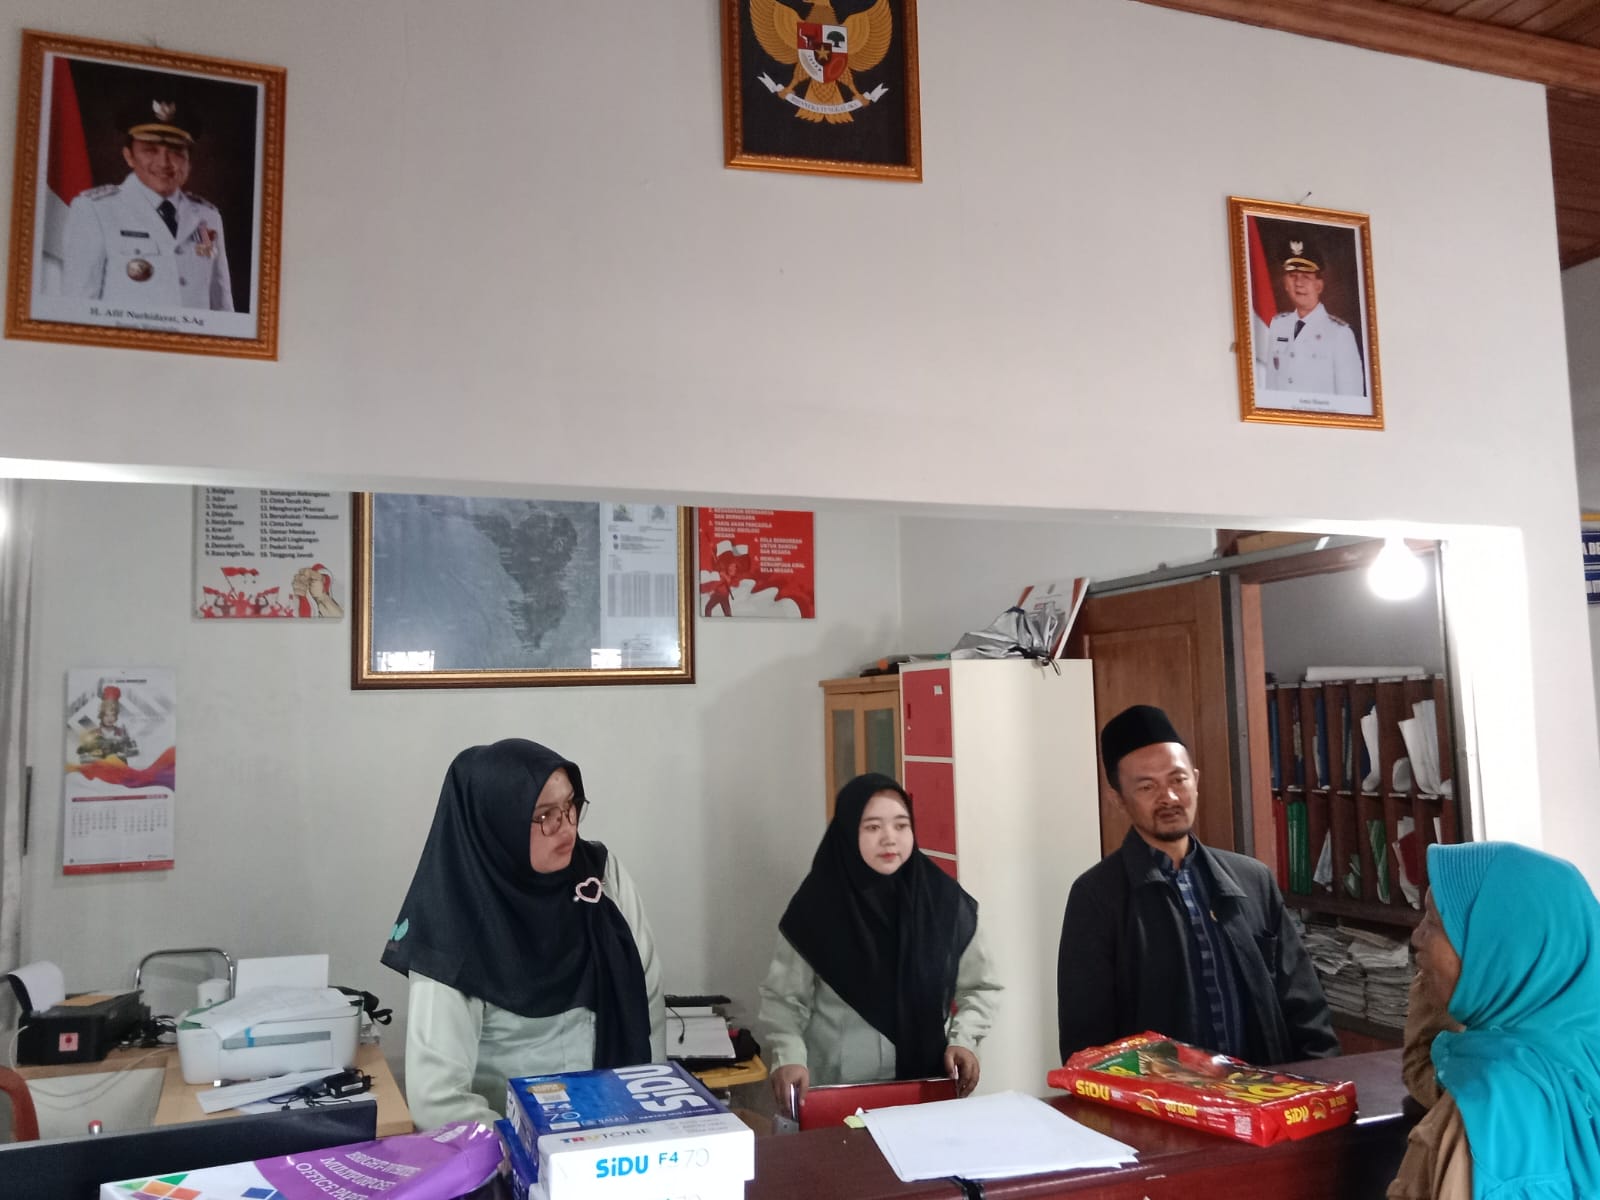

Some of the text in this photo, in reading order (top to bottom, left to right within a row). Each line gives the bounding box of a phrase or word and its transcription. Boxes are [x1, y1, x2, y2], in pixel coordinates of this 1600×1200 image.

[1076, 1080, 1110, 1100] SiDU
[1284, 1104, 1309, 1125] SiDU
[596, 1148, 710, 1178] SiDU F4 70
[296, 1163, 339, 1192] OFFICE
